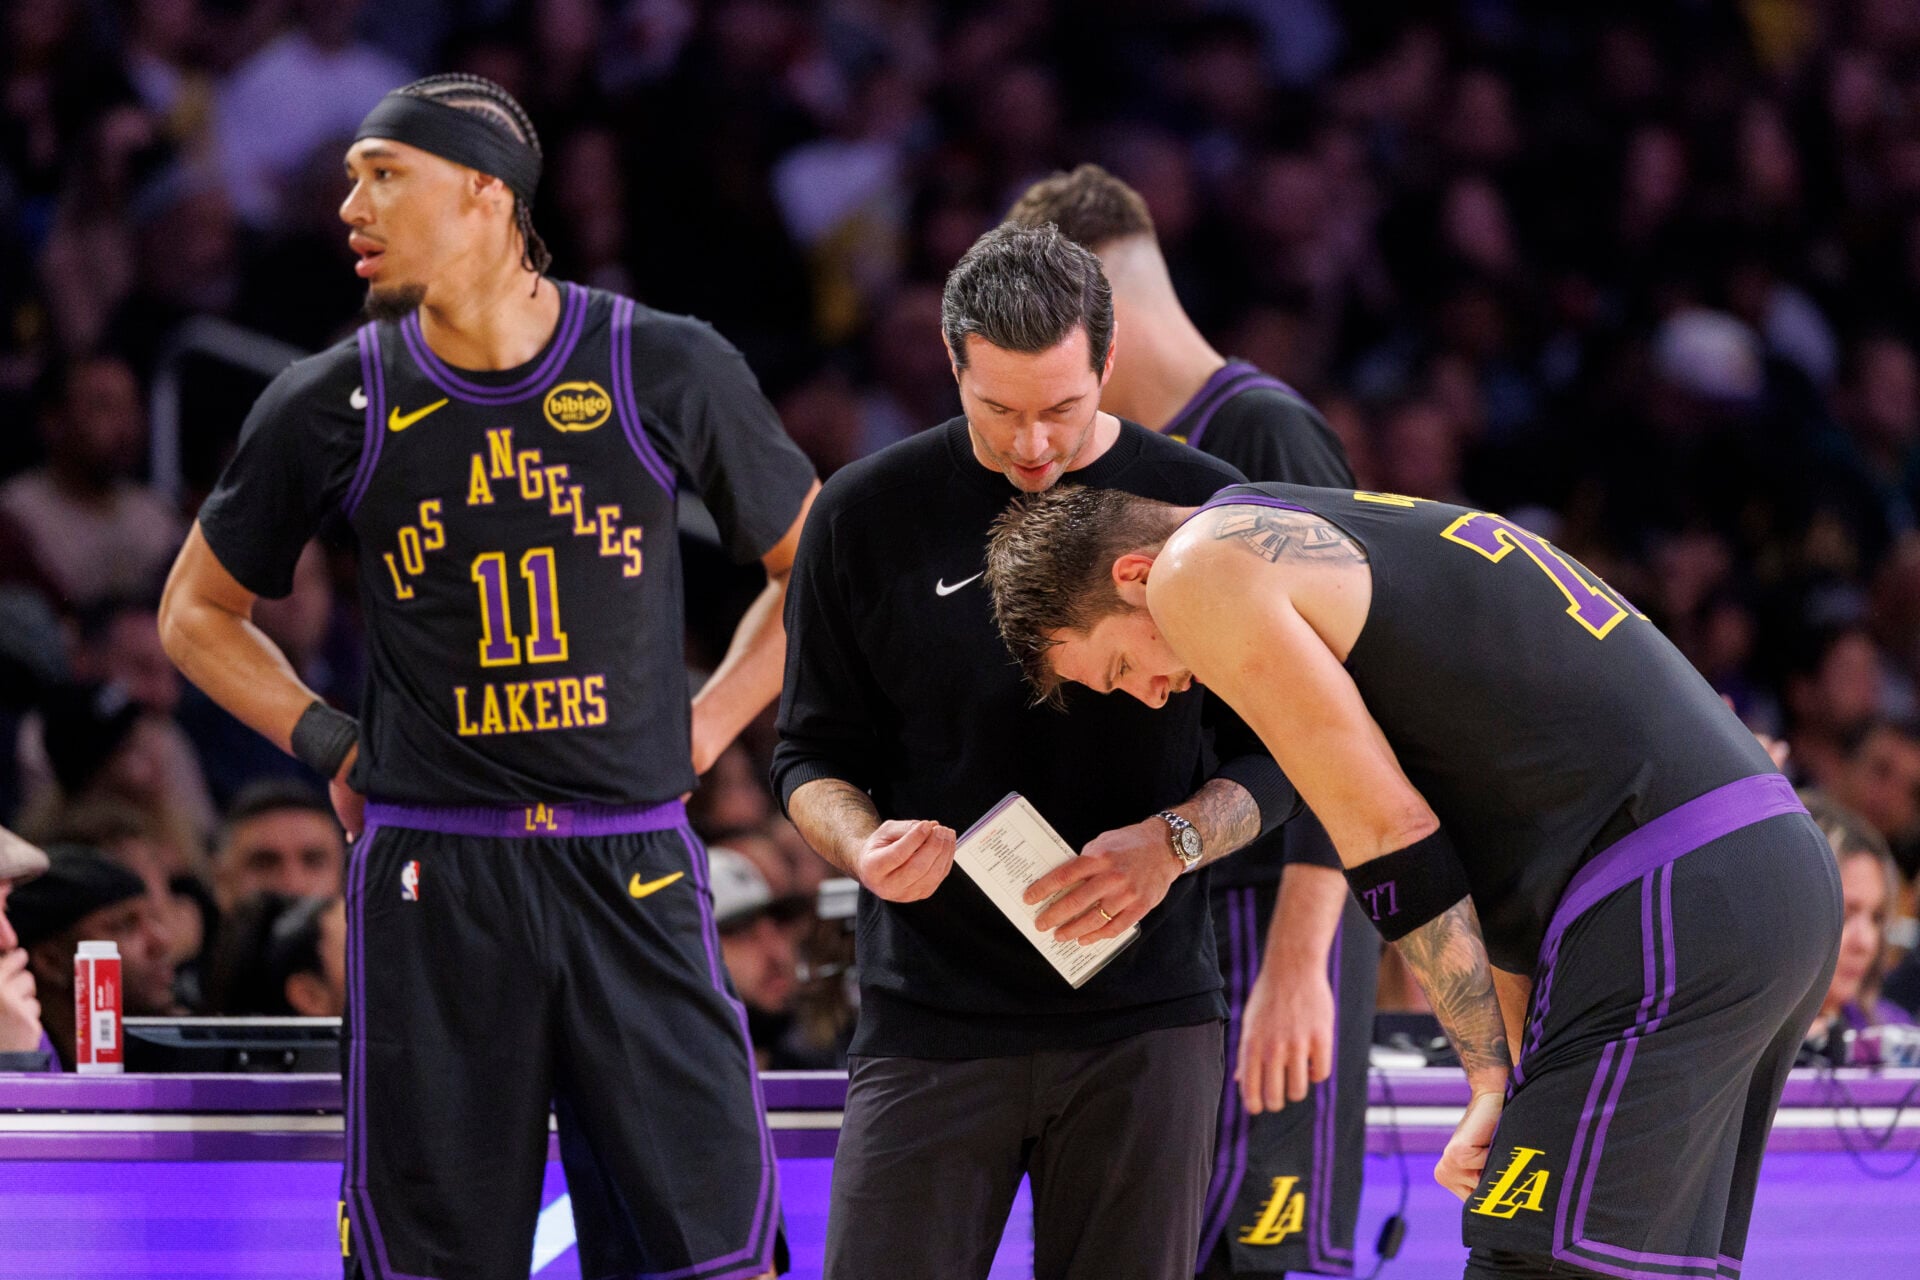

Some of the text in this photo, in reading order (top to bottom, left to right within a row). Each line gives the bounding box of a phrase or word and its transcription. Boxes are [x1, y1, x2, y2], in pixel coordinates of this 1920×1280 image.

[550, 394, 606, 417] bibigo
[383, 428, 643, 600] LOS ANGELES
[470, 546, 569, 668] 11
[1439, 511, 1651, 641] 7
[453, 674, 608, 737] LAKERS
[524, 802, 558, 831] LAL
[1361, 880, 1400, 920] 77
[1236, 1176, 1306, 1246] LA
[1470, 1146, 1551, 1220] LA
